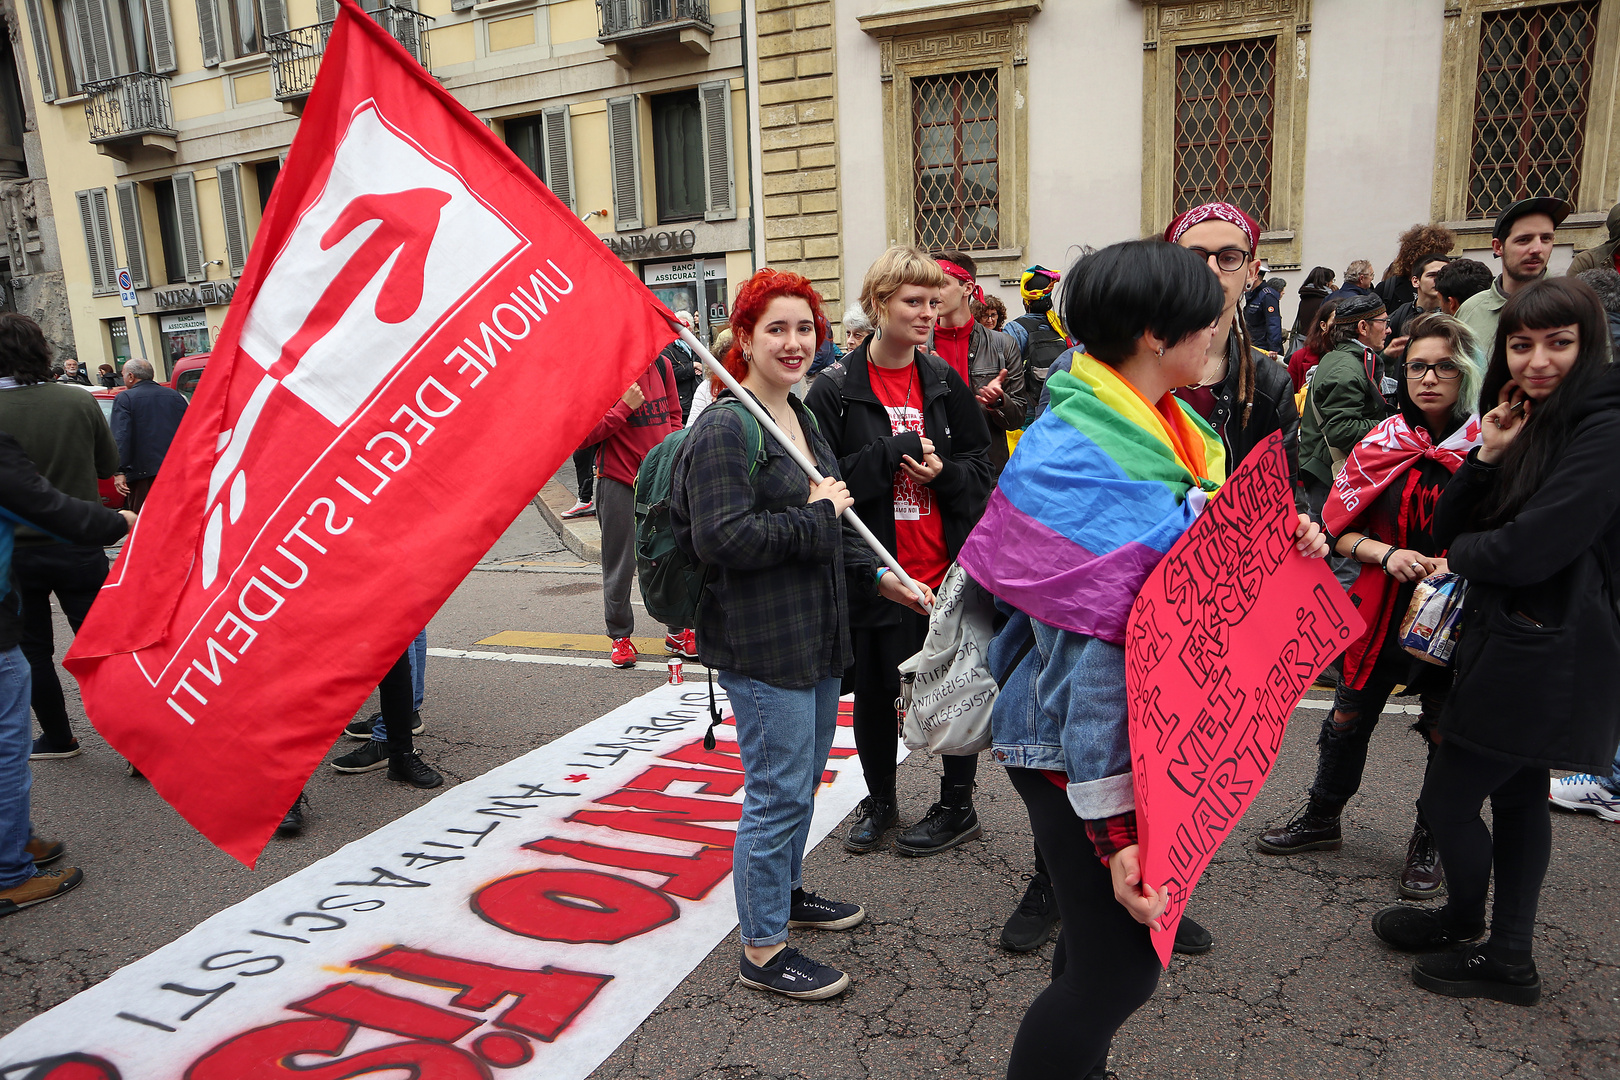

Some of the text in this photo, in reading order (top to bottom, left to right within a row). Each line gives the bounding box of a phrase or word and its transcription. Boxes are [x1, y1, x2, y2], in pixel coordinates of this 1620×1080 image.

[655, 269, 716, 282] ASSICURAZNE
[671, 263, 696, 272] BANCA
[154, 287, 199, 307] INTESA
[168, 320, 206, 330] ASSICURAZIONE
[632, 399, 669, 416] EPE JEAN
[1178, 501, 1296, 690] FASCISTI
[1166, 664, 1247, 798] NEI
